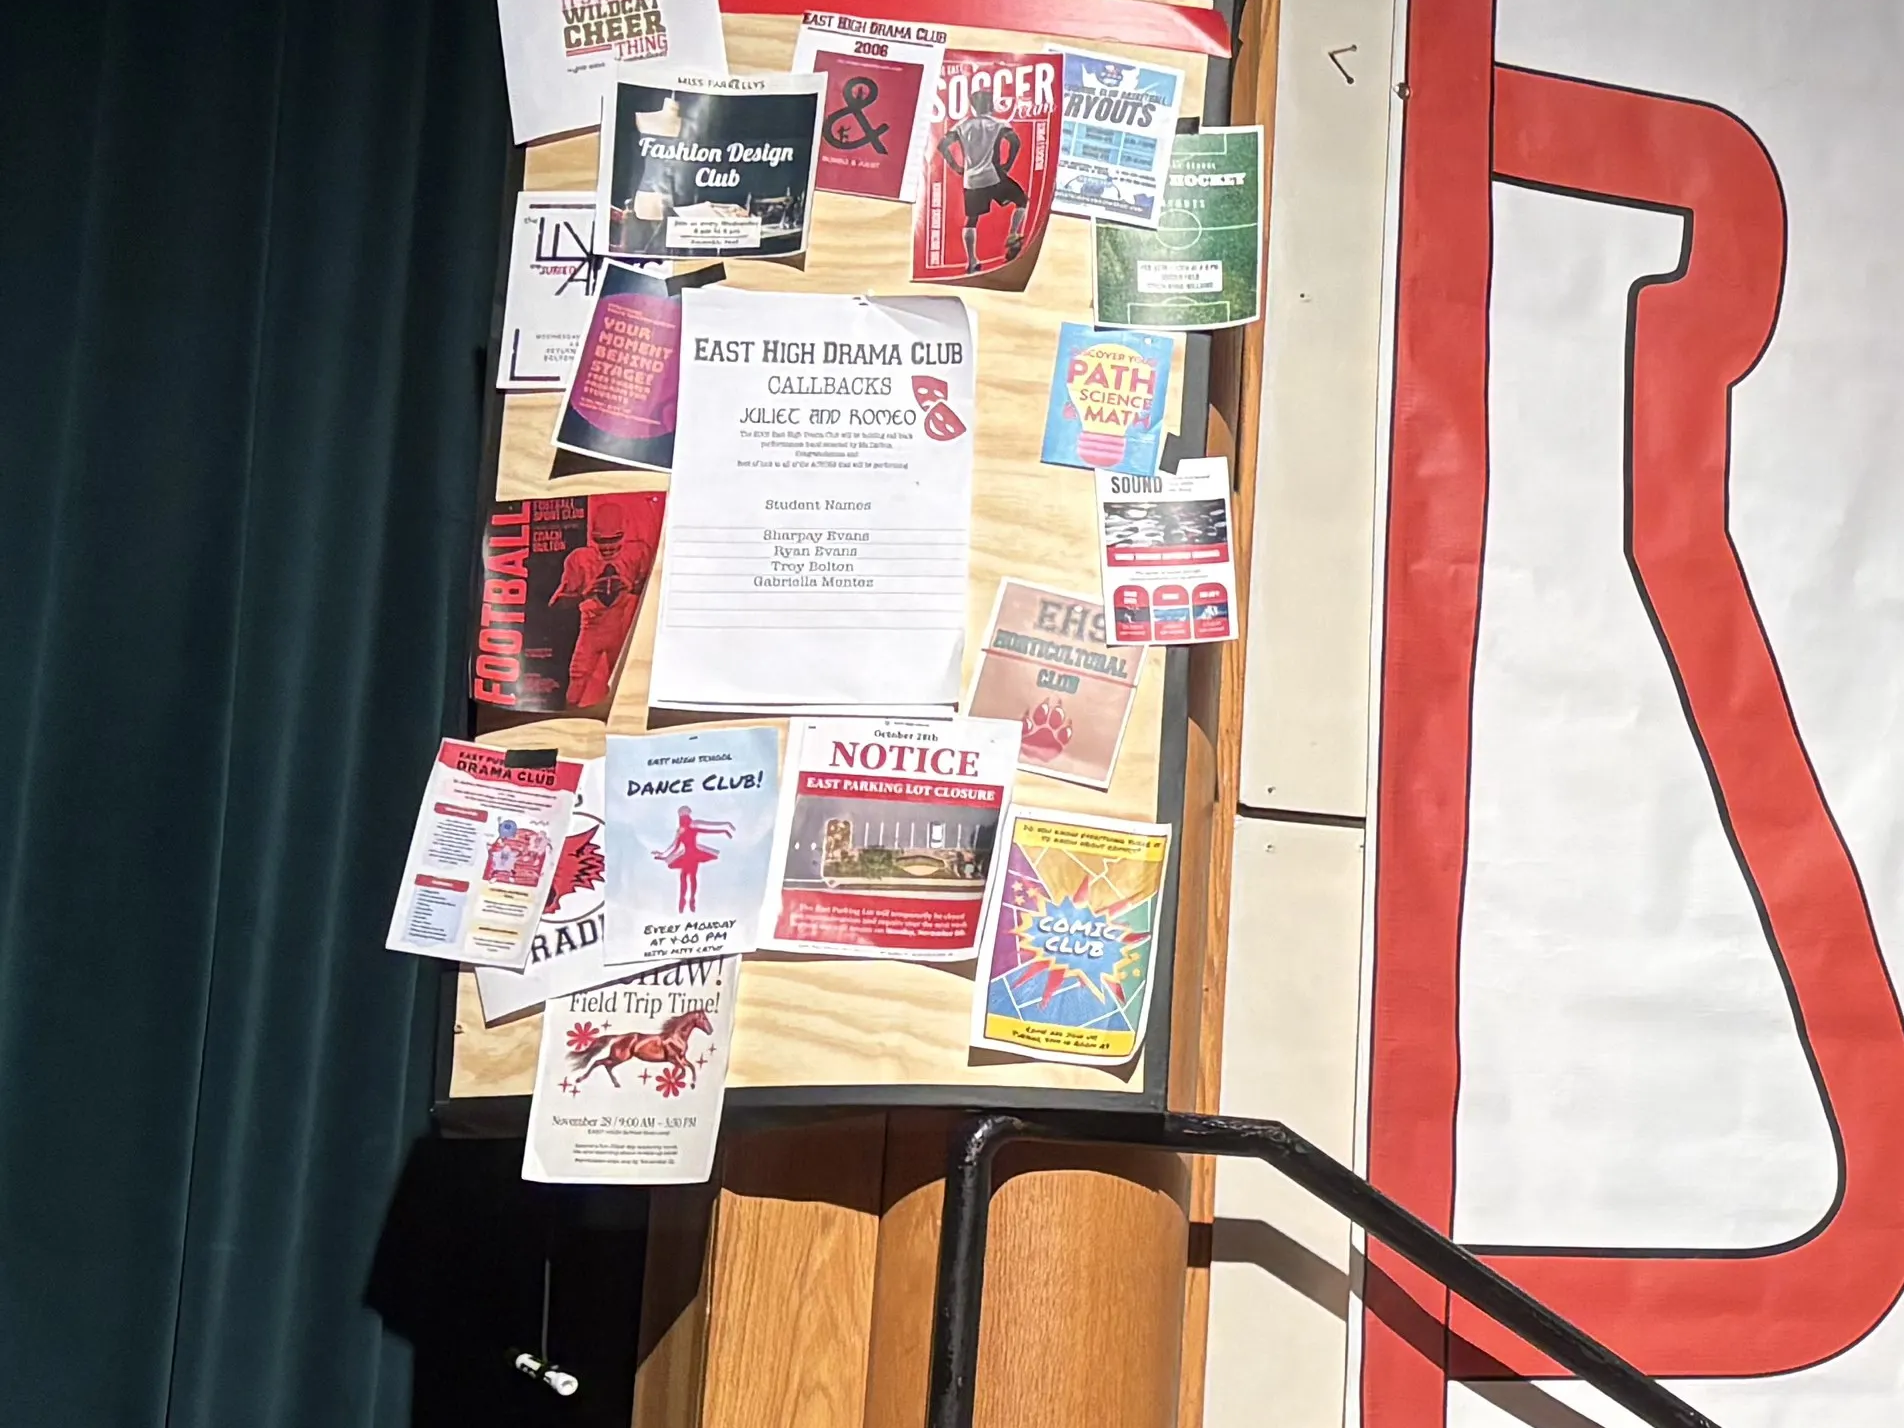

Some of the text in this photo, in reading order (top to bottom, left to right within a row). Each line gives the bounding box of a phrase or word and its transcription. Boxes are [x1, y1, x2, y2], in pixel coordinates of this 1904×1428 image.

[564, 10, 667, 48] CHEER
[802, 12, 947, 44] EAST HIGH DRAMA CLUB
[615, 34, 669, 58] THING
[930, 62, 1055, 124] SOCCER
[1064, 92, 1157, 128] RYOUTS
[639, 137, 794, 167] Fashion Design
[695, 167, 741, 188] Club
[604, 317, 651, 340] YOUR
[599, 330, 674, 361] MOMENT
[694, 337, 963, 365] EAST HIGH DRAMA CLUB
[595, 345, 665, 373] BEHIND
[767, 375, 892, 396] CALLBACKS
[1067, 359, 1157, 395] PATH
[1079, 388, 1153, 411] SCIENCE
[1084, 405, 1151, 429] MATH
[1111, 476, 1163, 494] SOUND
[765, 499, 872, 511] Student Names
[763, 529, 870, 543] Sharpay Evans
[774, 545, 858, 558] Ryan Evans
[771, 560, 854, 573] Troy Bolton
[753, 575, 874, 588] Gabriella Montez
[474, 500, 531, 706] FOOTBALL
[1034, 597, 1106, 643] EHS
[874, 729, 914, 741] October
[829, 741, 980, 777] NOTICE
[456, 760, 513, 781] DRAMA
[517, 771, 556, 787] CLUB
[626, 770, 764, 798] DANCE CLUB!
[806, 776, 996, 801] EAST PARKING LOT CLOSURE
[531, 913, 605, 964] RAD
[644, 919, 737, 936] EVERY MONDAY
[650, 936, 666, 948] AT
[705, 932, 728, 943] PM
[1039, 916, 1123, 941] COMIC
[1045, 936, 1104, 958] CLUB
[569, 991, 721, 1019] Field Trip Time!
[552, 1115, 598, 1128] November
